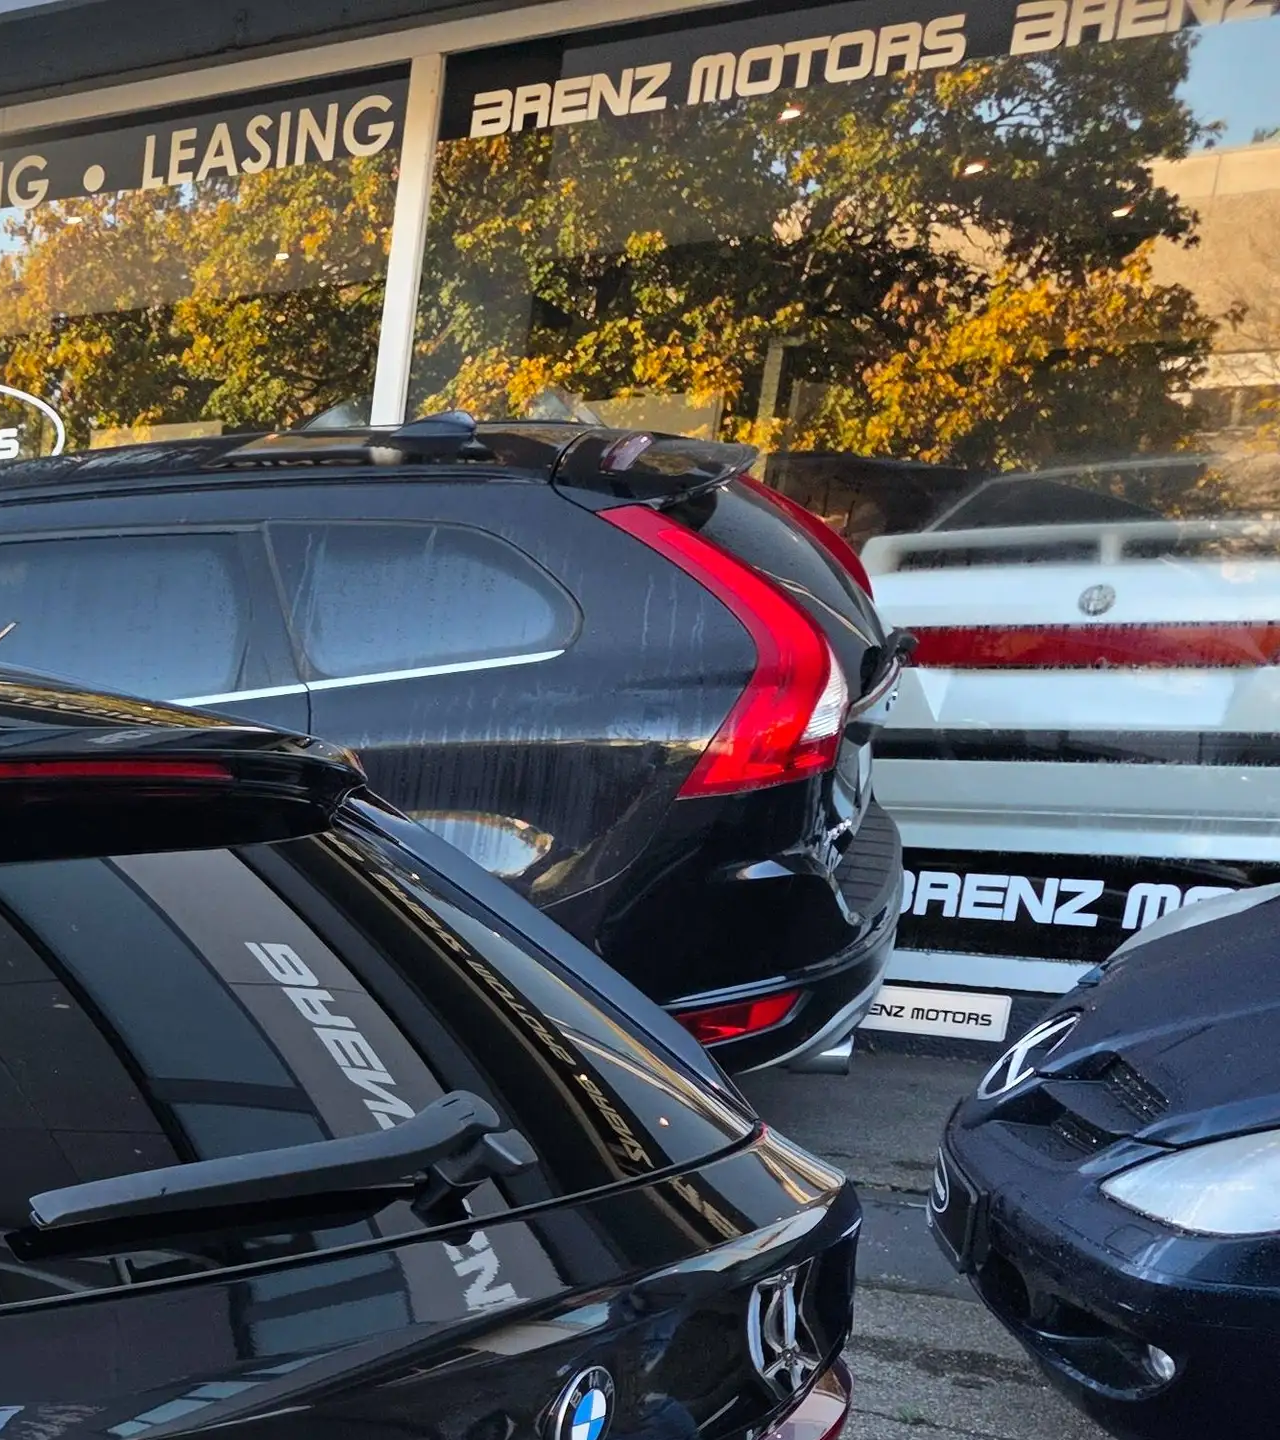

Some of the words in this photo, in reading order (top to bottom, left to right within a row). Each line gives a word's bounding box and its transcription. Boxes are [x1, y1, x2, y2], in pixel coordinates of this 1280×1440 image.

[470, 62, 671, 138] BRENZ
[687, 14, 966, 107] MOTORS
[141, 94, 395, 189] LEASING
[868, 1003, 905, 1018] ENZ
[910, 1007, 993, 1027] MOTORS
